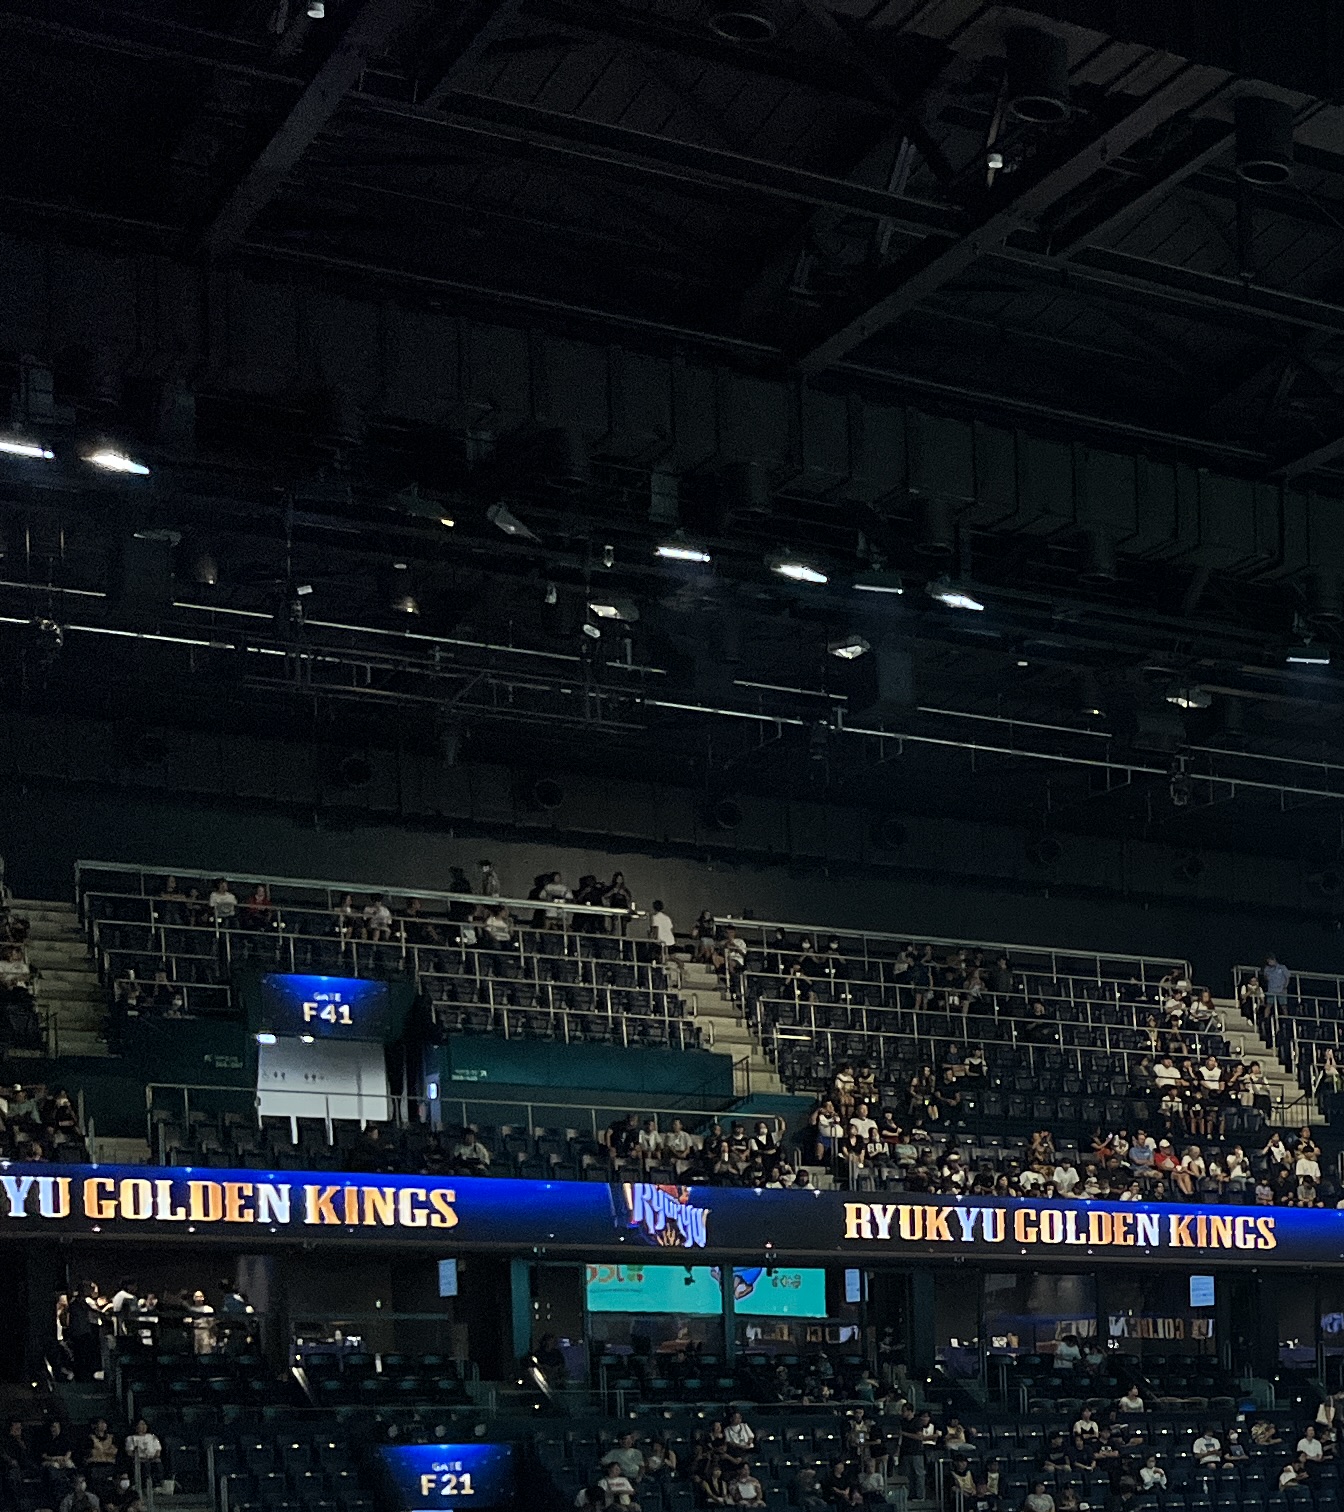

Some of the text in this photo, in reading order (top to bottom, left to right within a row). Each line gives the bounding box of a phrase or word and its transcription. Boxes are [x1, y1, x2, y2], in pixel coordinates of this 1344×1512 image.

[303, 1002, 353, 1025] F41
[83, 1178, 291, 1224] GOLDEN
[303, 1185, 459, 1228] KINGS
[844, 1202, 1277, 1250] RYUKYU GOLDEN KINGS
[421, 1473, 474, 1496] F21
